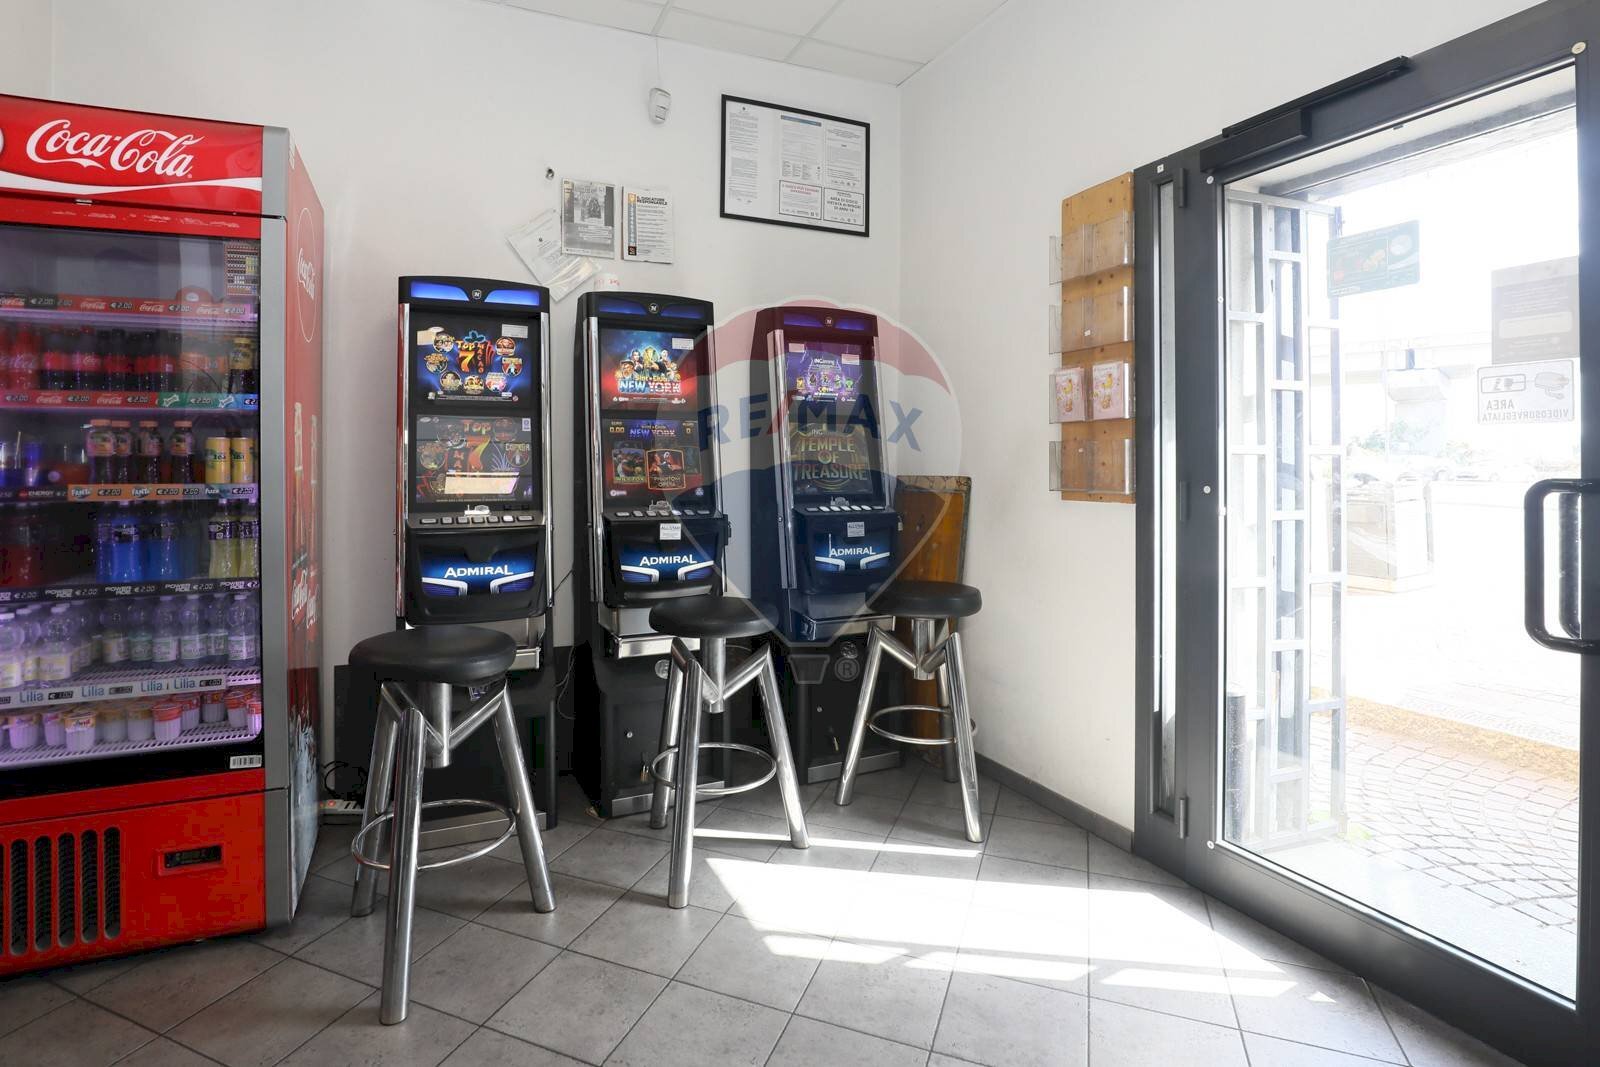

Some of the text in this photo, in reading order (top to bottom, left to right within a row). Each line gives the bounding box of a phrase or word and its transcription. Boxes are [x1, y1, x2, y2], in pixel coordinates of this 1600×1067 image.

[26, 119, 205, 178] Coca-Cola
[800, 437, 855, 453] TEMPLE
[818, 450, 840, 465] OF
[793, 463, 868, 481] TREASURE
[830, 546, 876, 557] ADMIRAL
[639, 554, 698, 567] ADMIRAL
[444, 564, 514, 579] ADMIRAL
[140, 680, 162, 692] Lilia
[173, 678, 196, 689] Lilia
[19, 691, 44, 703] Lilia
[81, 686, 105, 698] Lilia
